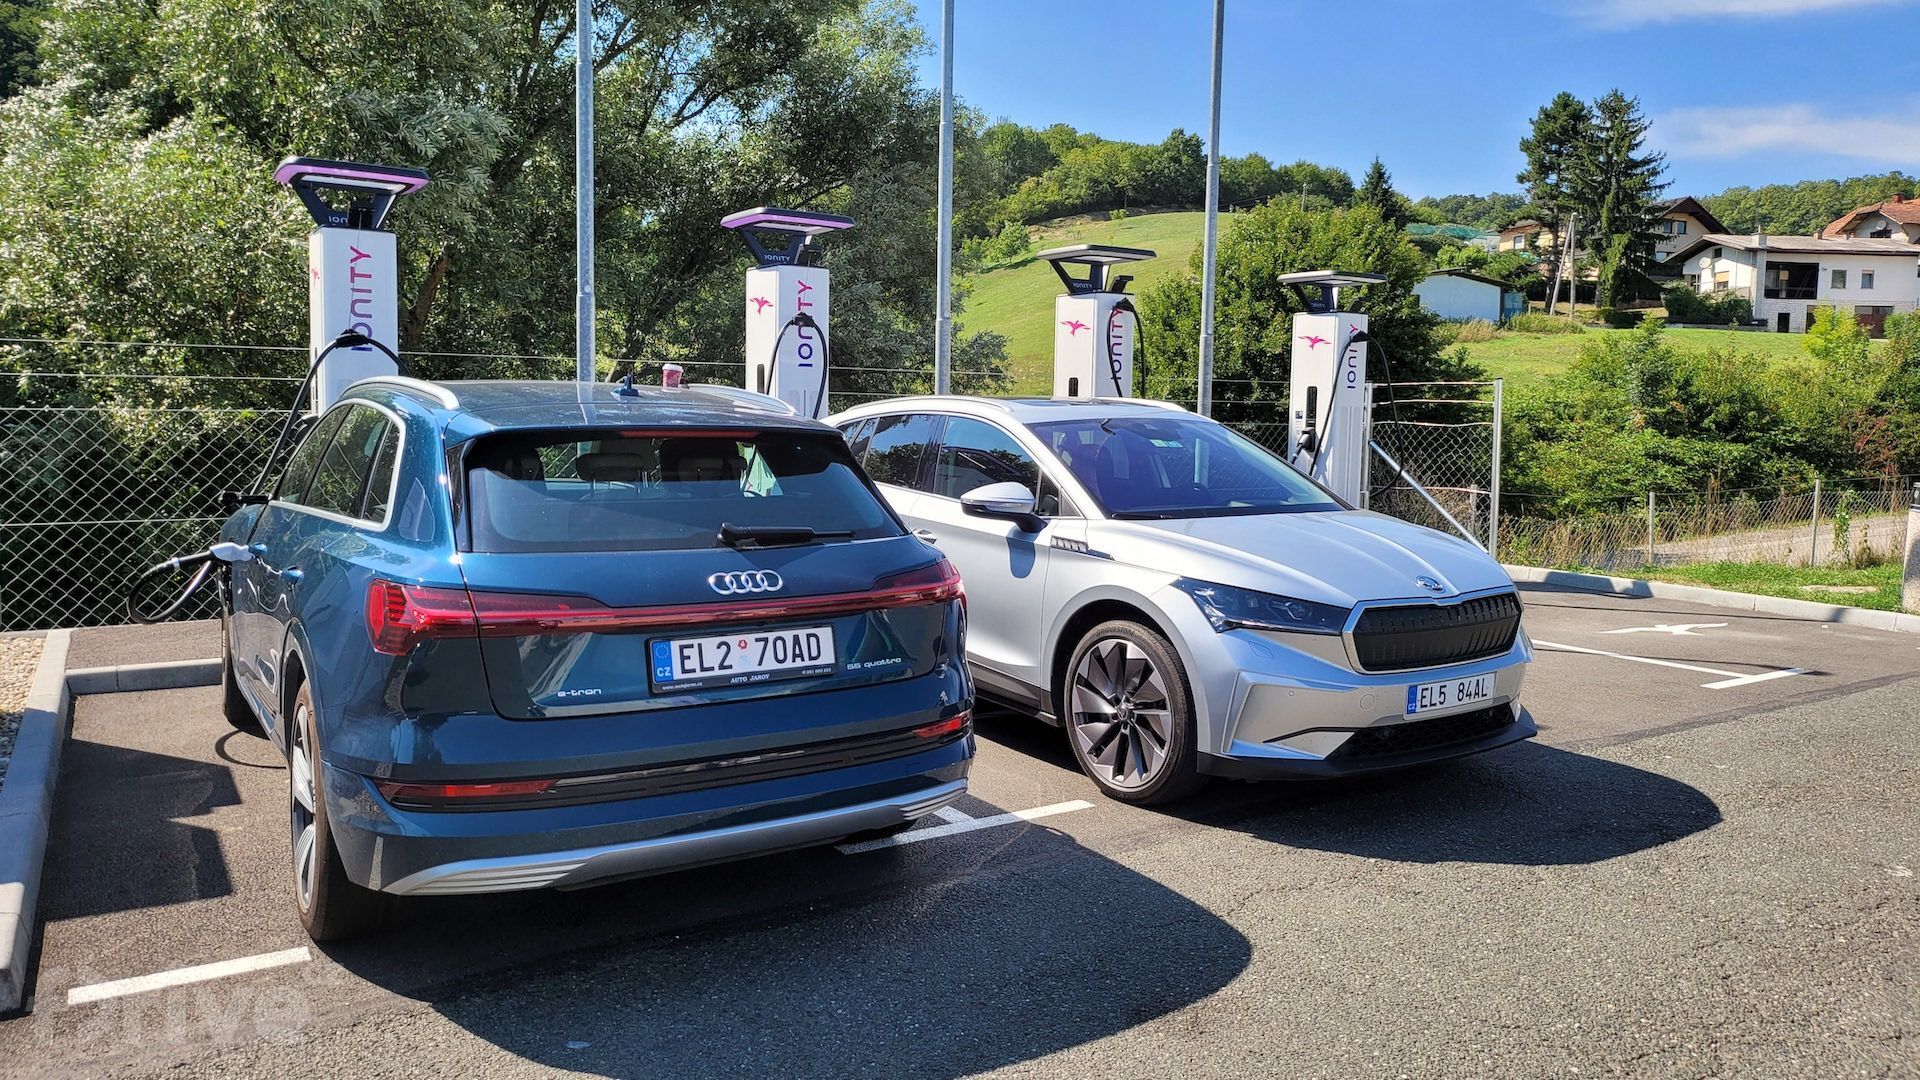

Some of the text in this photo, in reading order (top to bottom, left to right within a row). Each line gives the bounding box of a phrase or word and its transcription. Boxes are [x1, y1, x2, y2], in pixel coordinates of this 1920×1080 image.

[797, 279, 813, 368] IONTY
[678, 632, 822, 674] EL2 70AD
[863, 657, 902, 669] quattro
[656, 666, 671, 678] CZ
[730, 673, 771, 684] AUTO JAROV
[557, 688, 602, 698] e-tron
[1419, 677, 1488, 709] EL5 84AL
[1407, 702, 1416, 711] CZ
